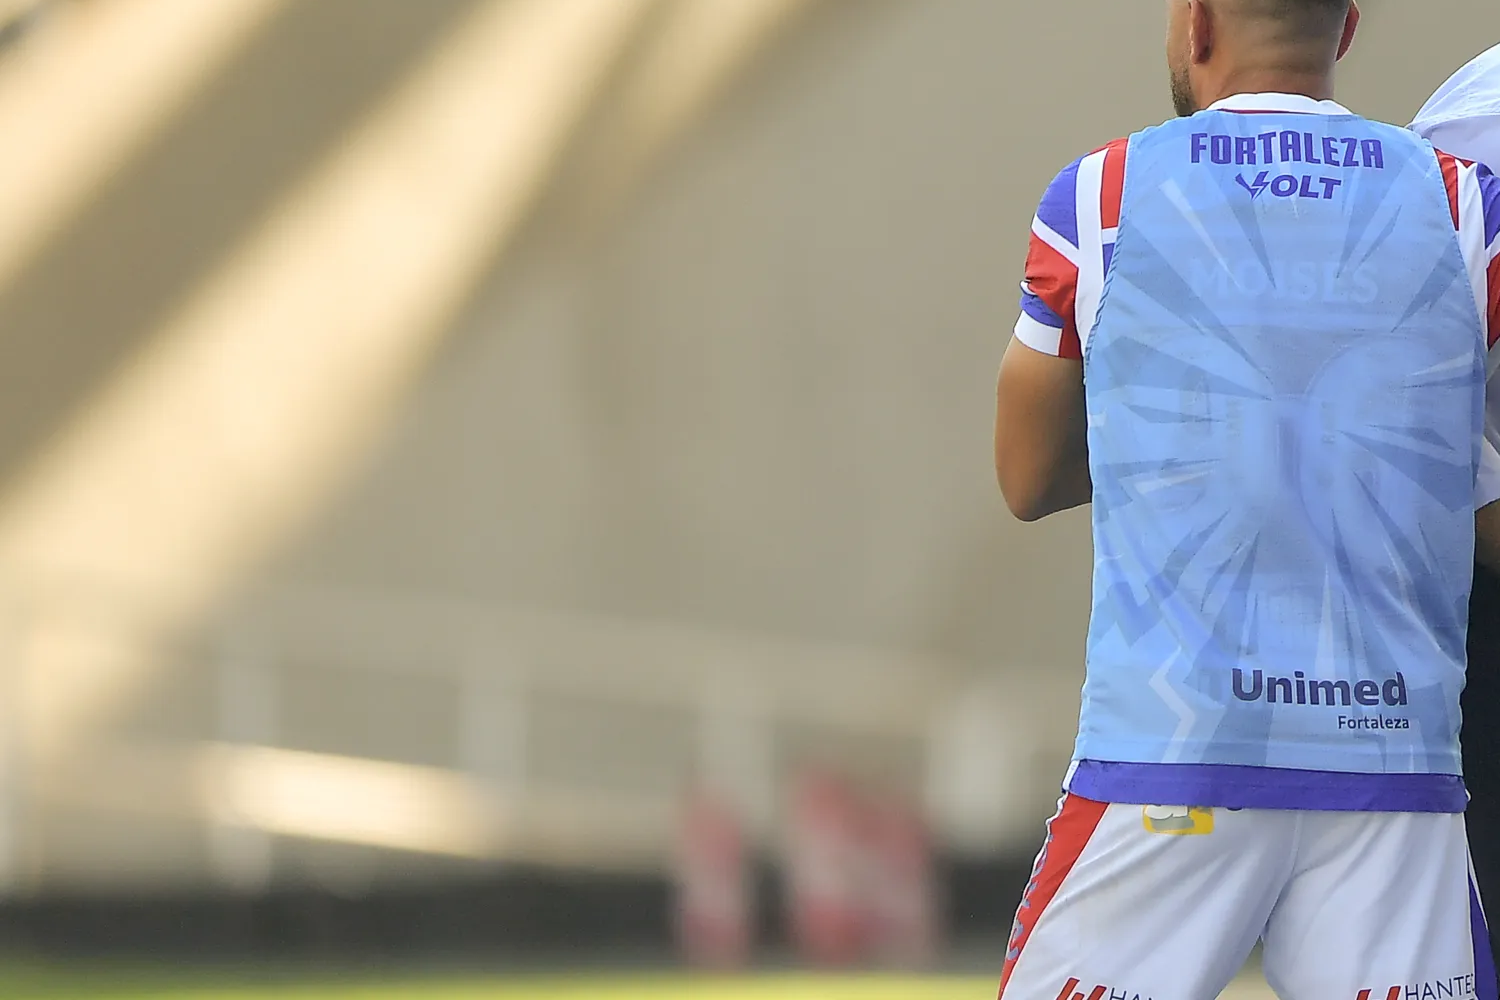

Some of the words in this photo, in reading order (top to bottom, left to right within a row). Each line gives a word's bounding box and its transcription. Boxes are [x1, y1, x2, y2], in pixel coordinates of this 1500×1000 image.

[1190, 130, 1385, 169] FORTALEZA
[1234, 170, 1342, 200] VOLT
[1231, 667, 1408, 707] Unimed
[1337, 713, 1410, 730] Fortaleza
